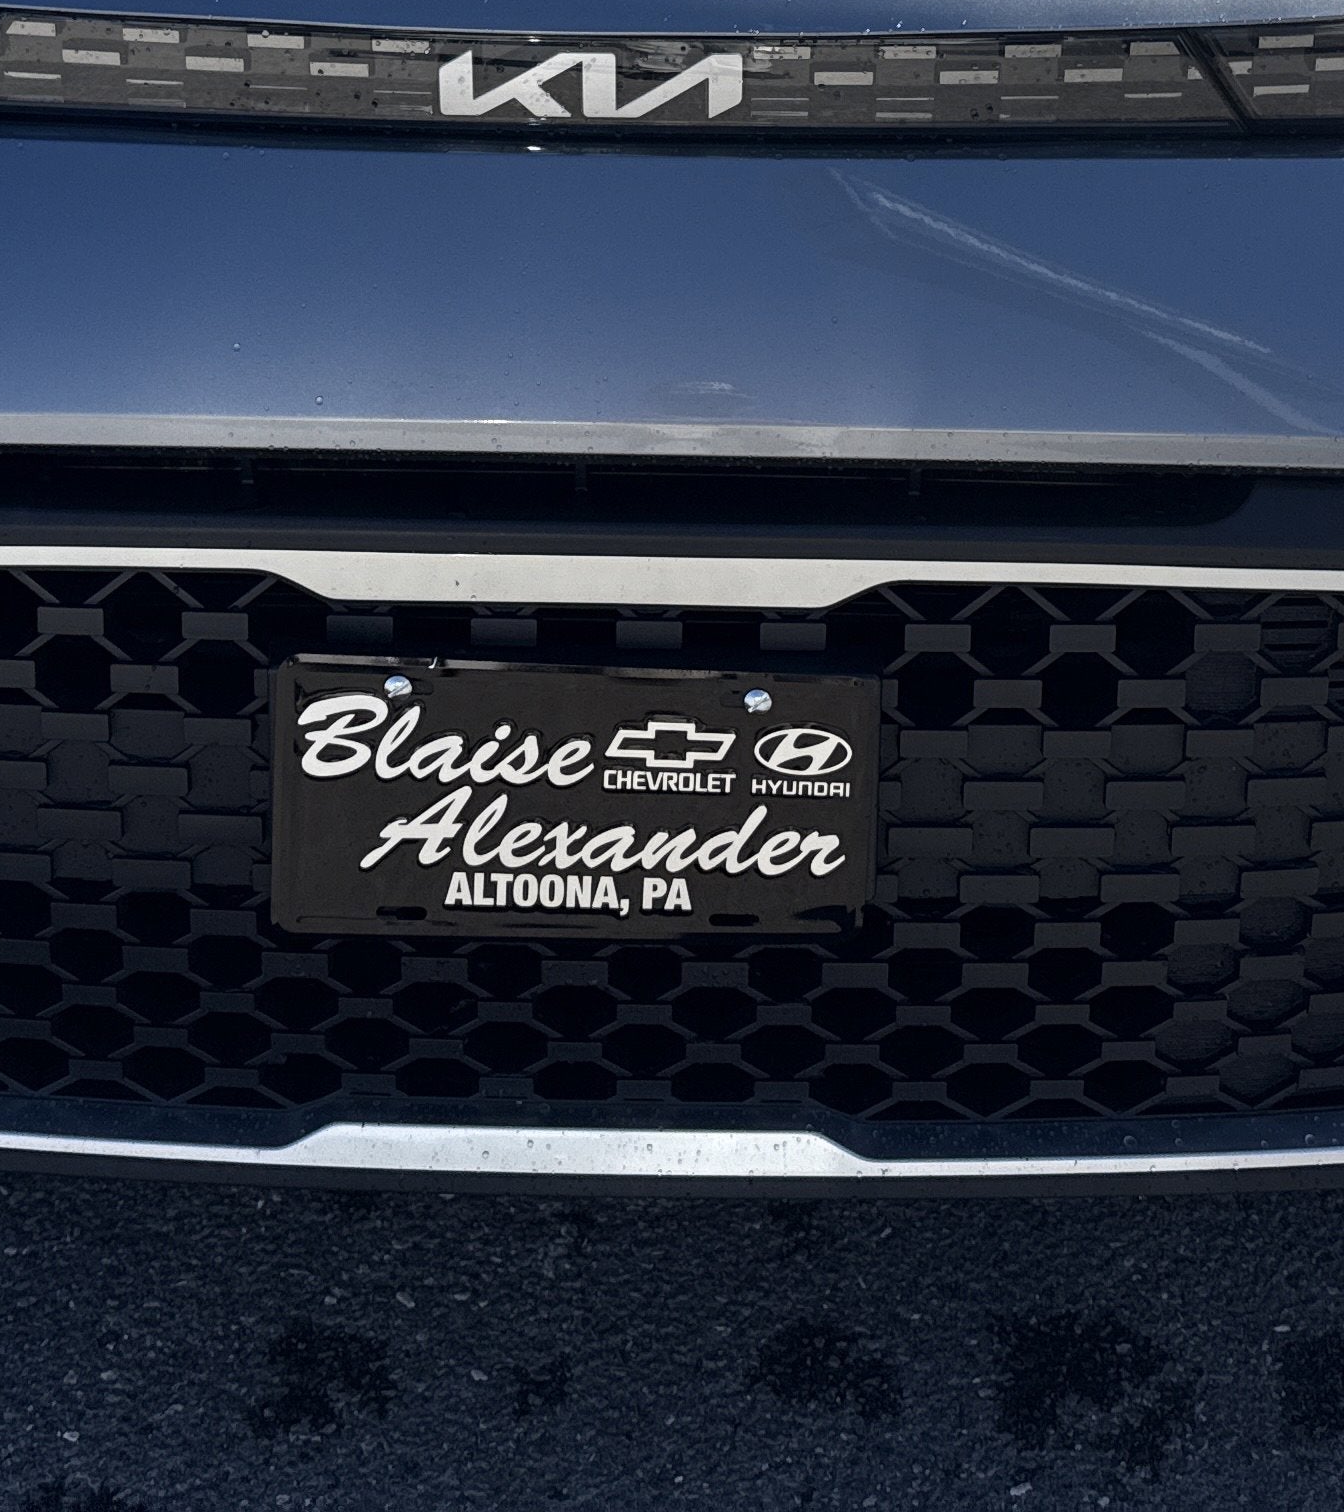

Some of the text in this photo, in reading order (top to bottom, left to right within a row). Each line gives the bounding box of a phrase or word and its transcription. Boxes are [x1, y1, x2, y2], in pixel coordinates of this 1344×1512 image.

[439, 50, 743, 118] KIA
[297, 694, 594, 786] Blaise
[603, 769, 737, 793] CHEVROLET
[751, 779, 851, 798] HYUNDAI
[359, 785, 845, 876] Alexander
[444, 871, 692, 916] ALTOONA, PA
